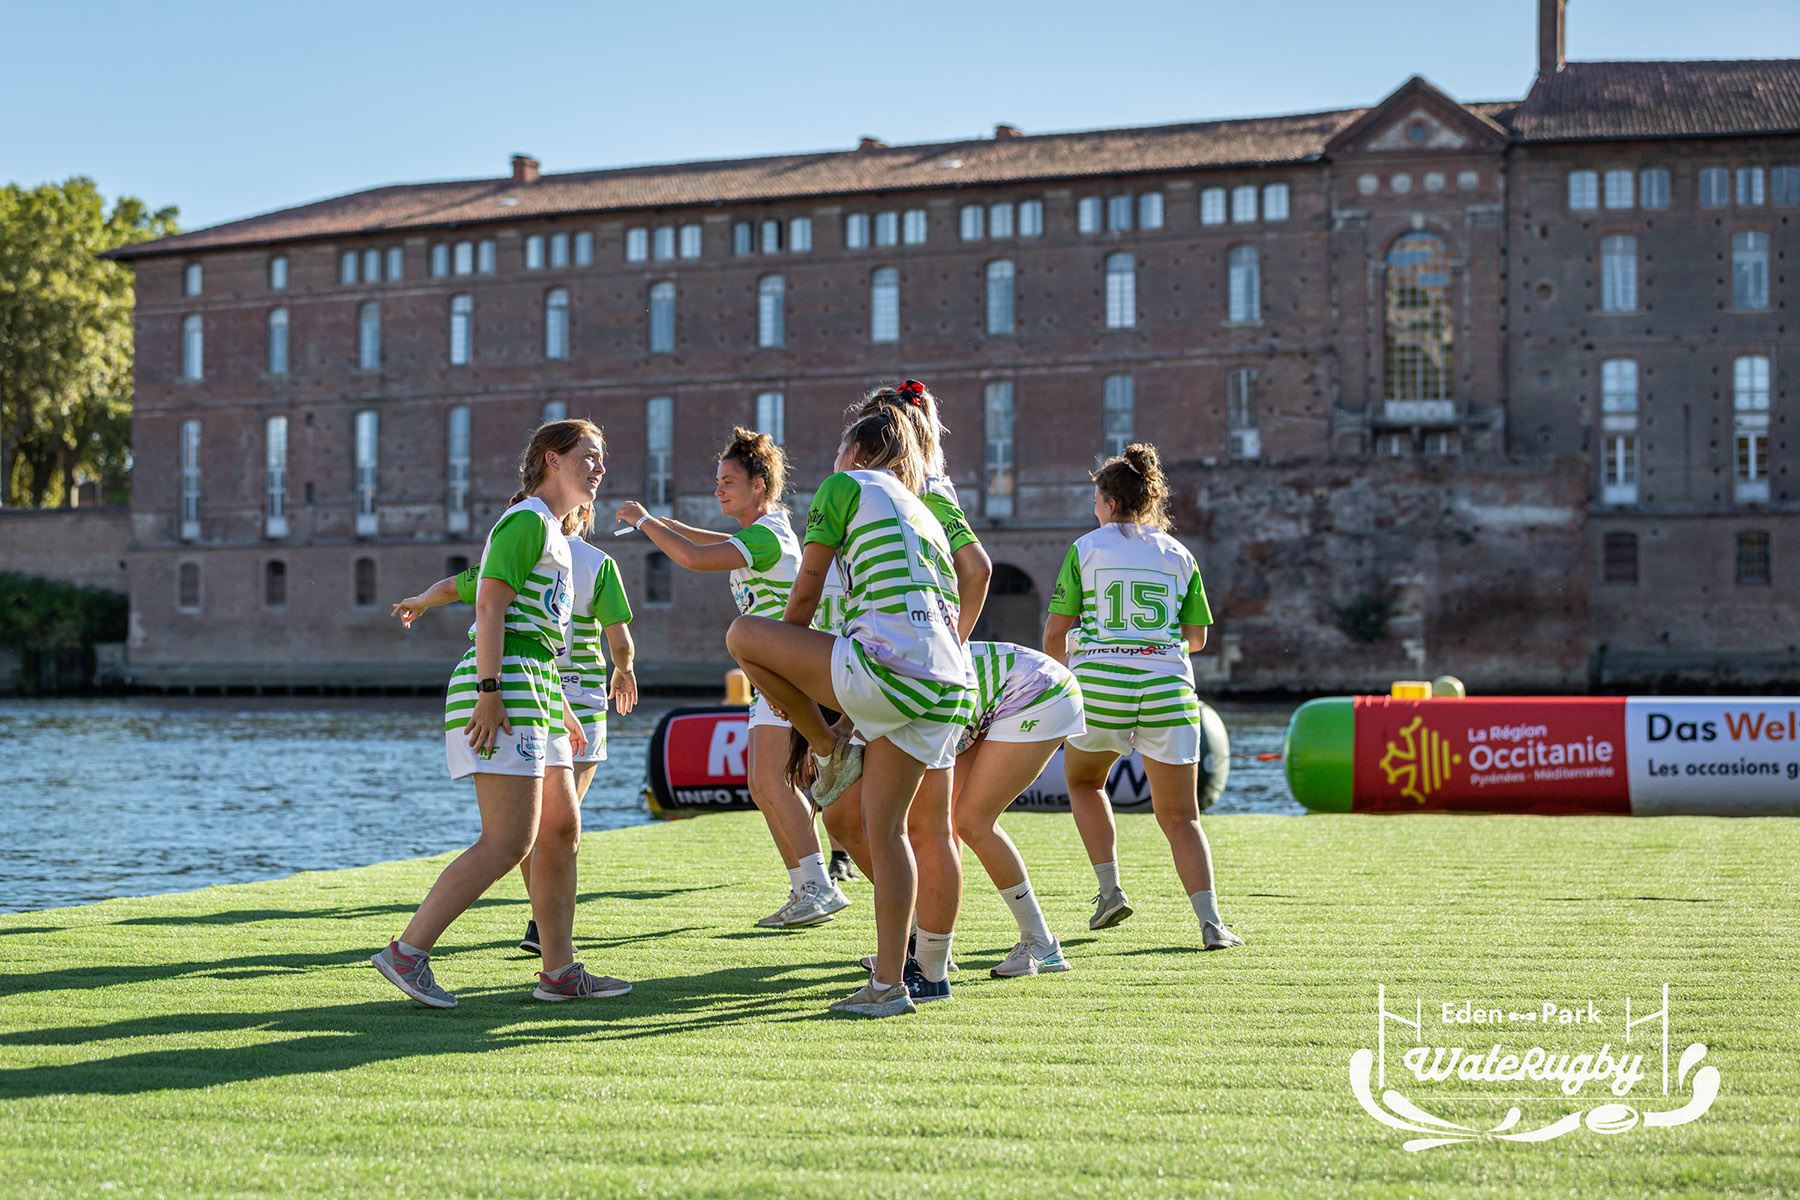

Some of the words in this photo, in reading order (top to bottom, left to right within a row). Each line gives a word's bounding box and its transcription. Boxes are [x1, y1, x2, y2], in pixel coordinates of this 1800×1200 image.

[1104, 580, 1169, 631] 15
[1467, 728, 1487, 743] La
[1489, 723, 1548, 743] Région
[1647, 712, 1717, 741] Das
[1723, 711, 1800, 741] Wel
[1468, 735, 1614, 771] Occitanie
[1648, 757, 1679, 777] Les
[1685, 757, 1780, 777] occasions
[676, 789, 733, 805] INFO
